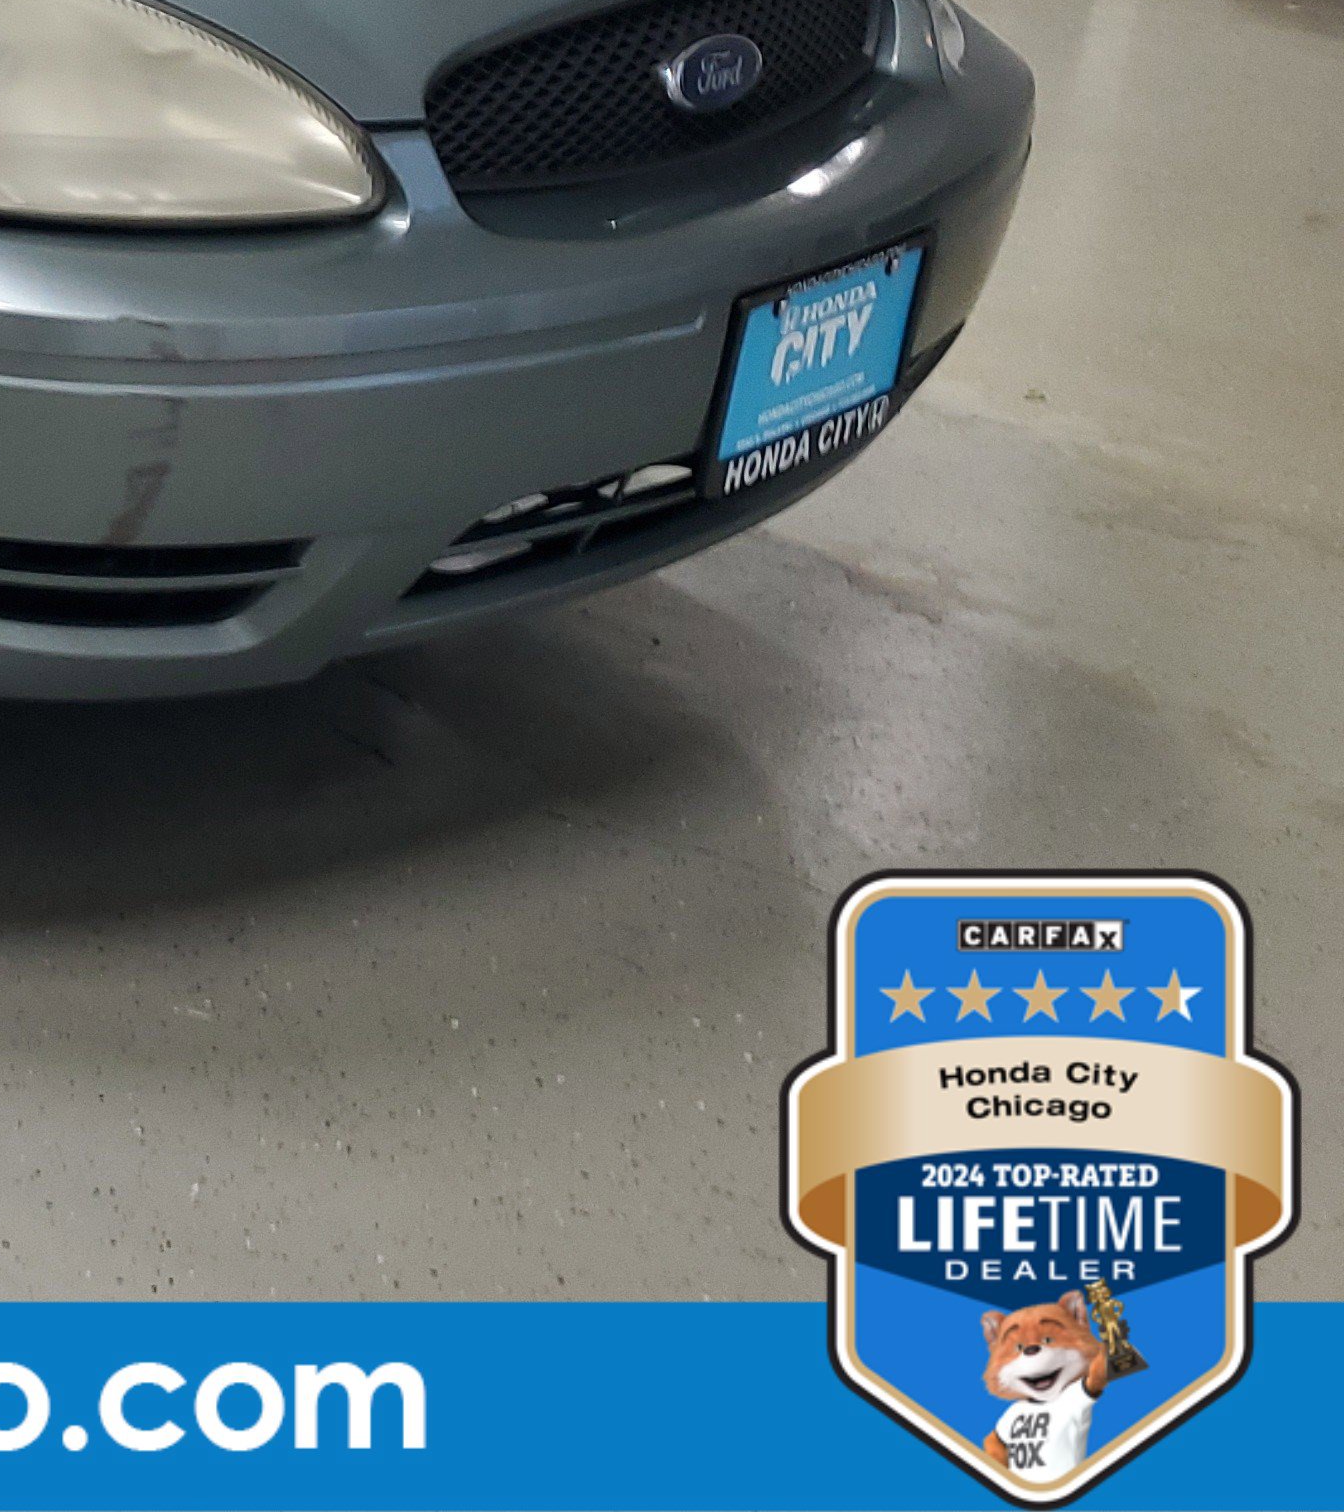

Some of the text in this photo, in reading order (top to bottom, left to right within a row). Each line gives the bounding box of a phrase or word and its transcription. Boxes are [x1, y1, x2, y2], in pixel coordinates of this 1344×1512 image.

[697, 49, 744, 95] Ford
[801, 280, 878, 327] HONDA
[770, 302, 874, 386] CITY
[723, 434, 811, 495] HONDA
[817, 402, 870, 456] CITY
